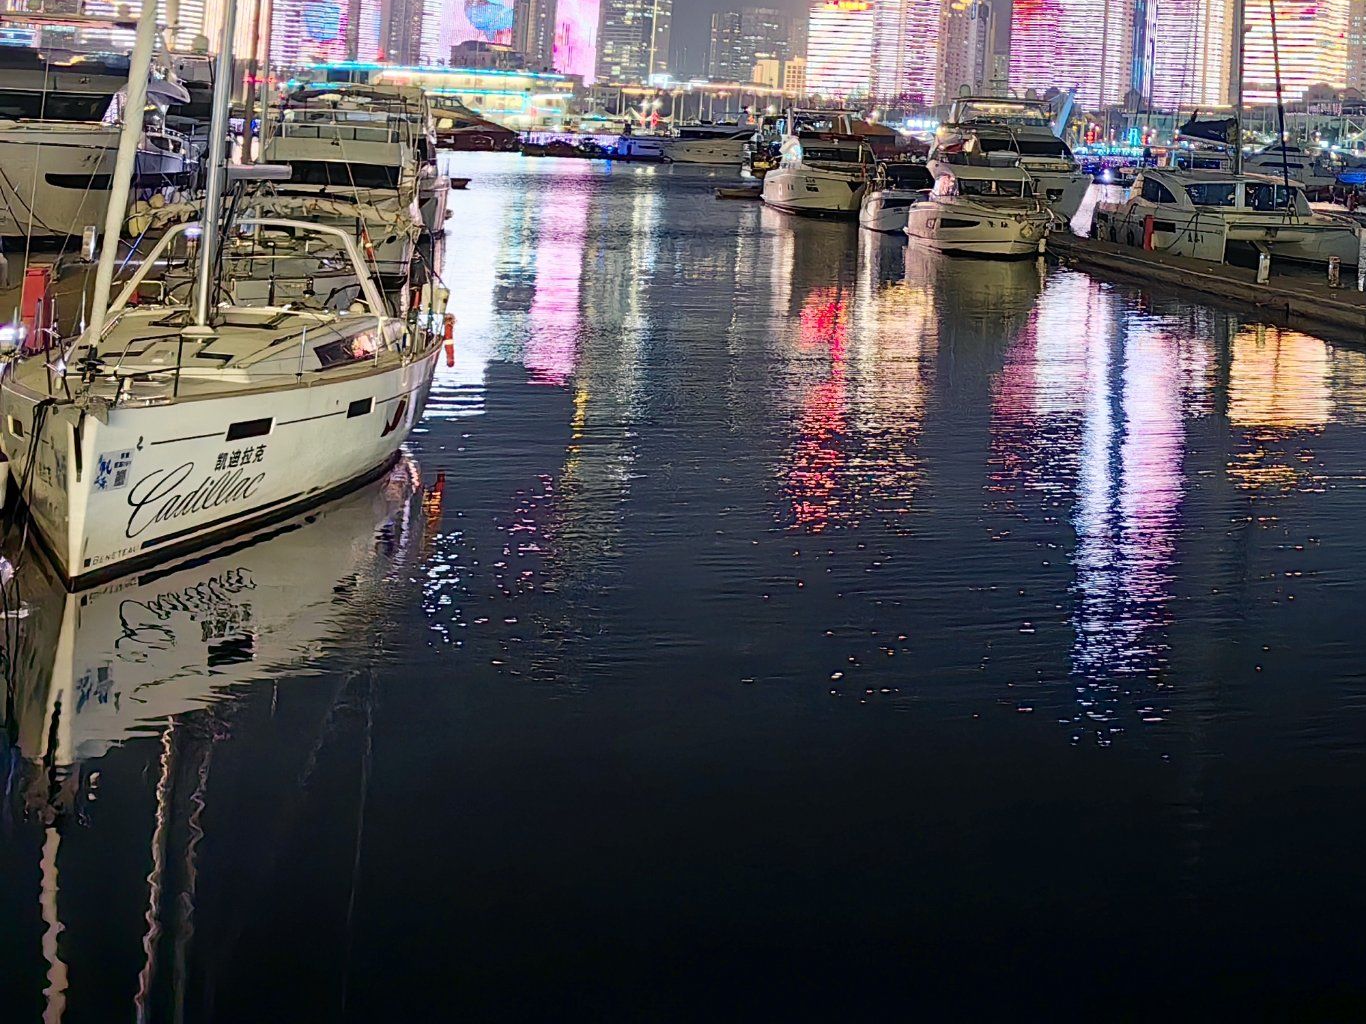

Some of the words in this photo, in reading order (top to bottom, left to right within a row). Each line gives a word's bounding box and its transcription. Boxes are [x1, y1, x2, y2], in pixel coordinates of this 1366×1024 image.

[215, 444, 266, 471] 凯迪拉克
[126, 461, 266, 538] Cadillac
